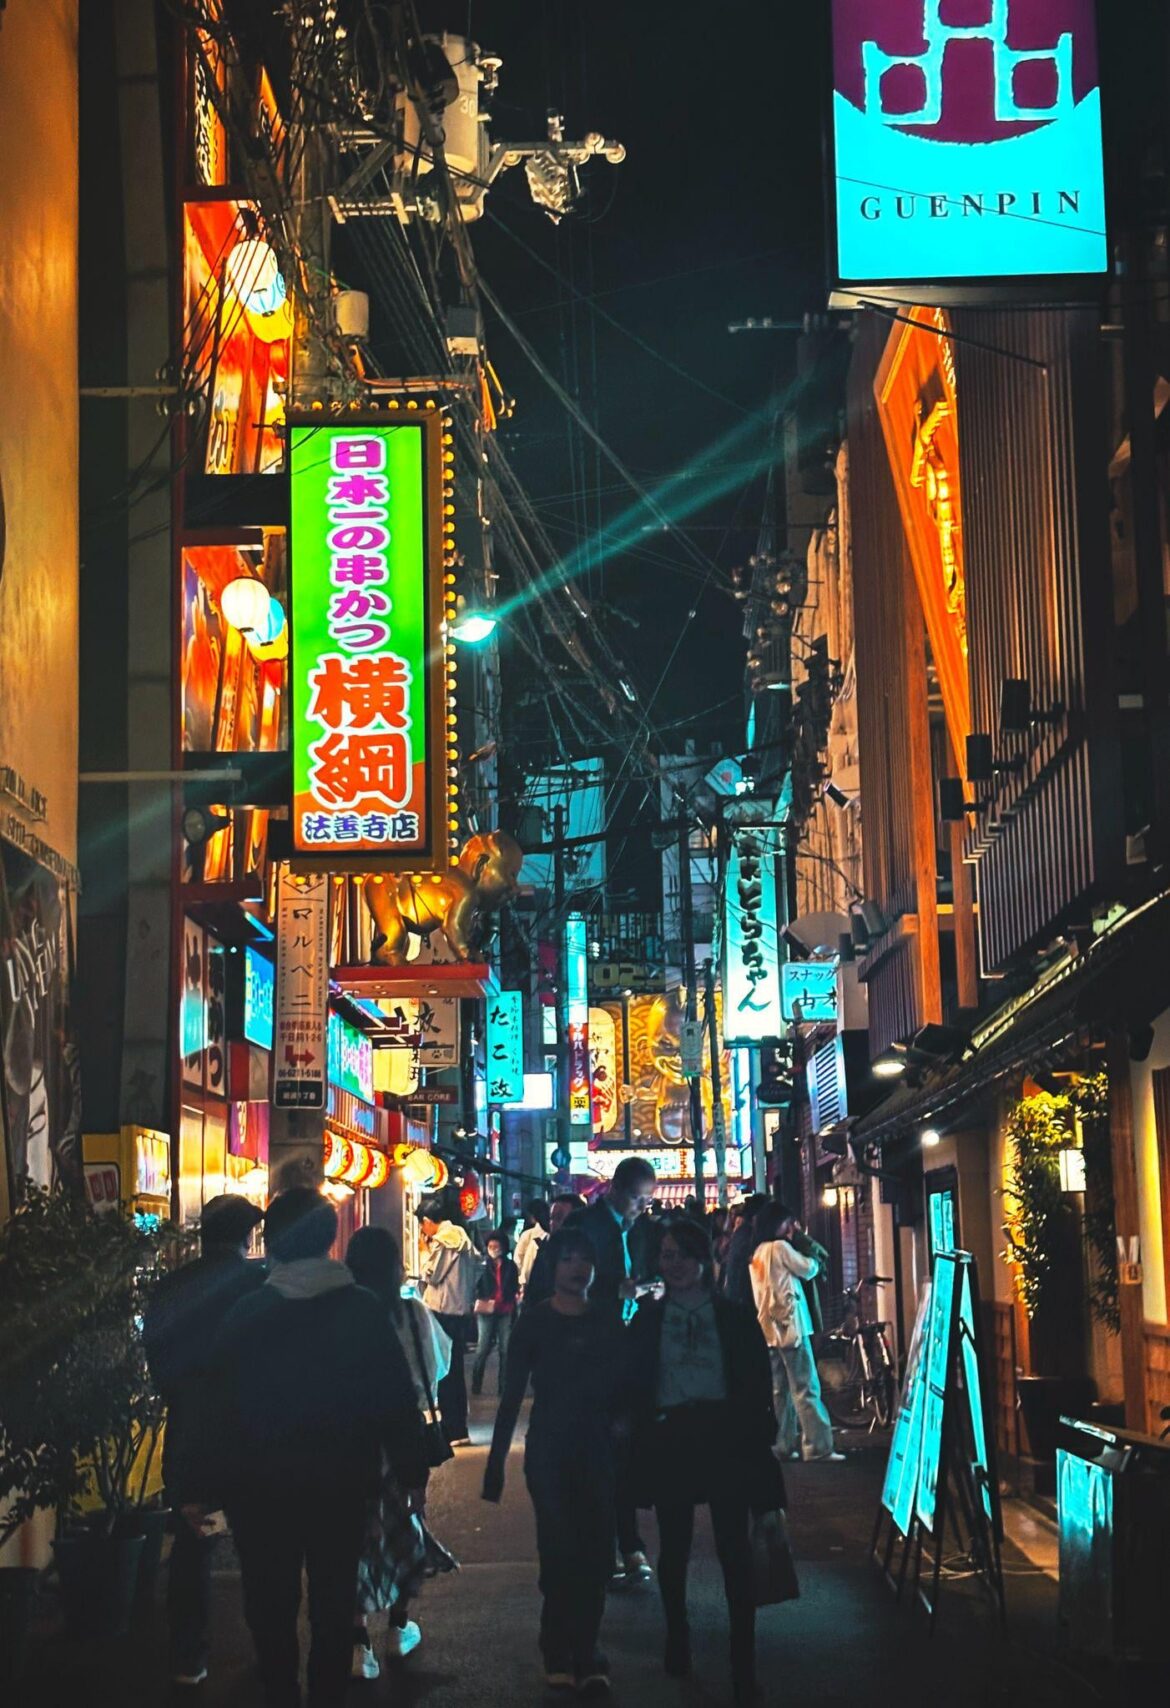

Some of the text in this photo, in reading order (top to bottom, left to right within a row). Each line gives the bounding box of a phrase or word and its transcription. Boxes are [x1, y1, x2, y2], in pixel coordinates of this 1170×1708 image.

[860, 190, 1081, 221] GUENPIN
[328, 436, 391, 650] 日本一の串かつ
[308, 654, 412, 807] 横綱
[303, 811, 420, 843] 法善寺店
[291, 907, 314, 1007] マルベニ
[789, 968, 839, 982] スナック
